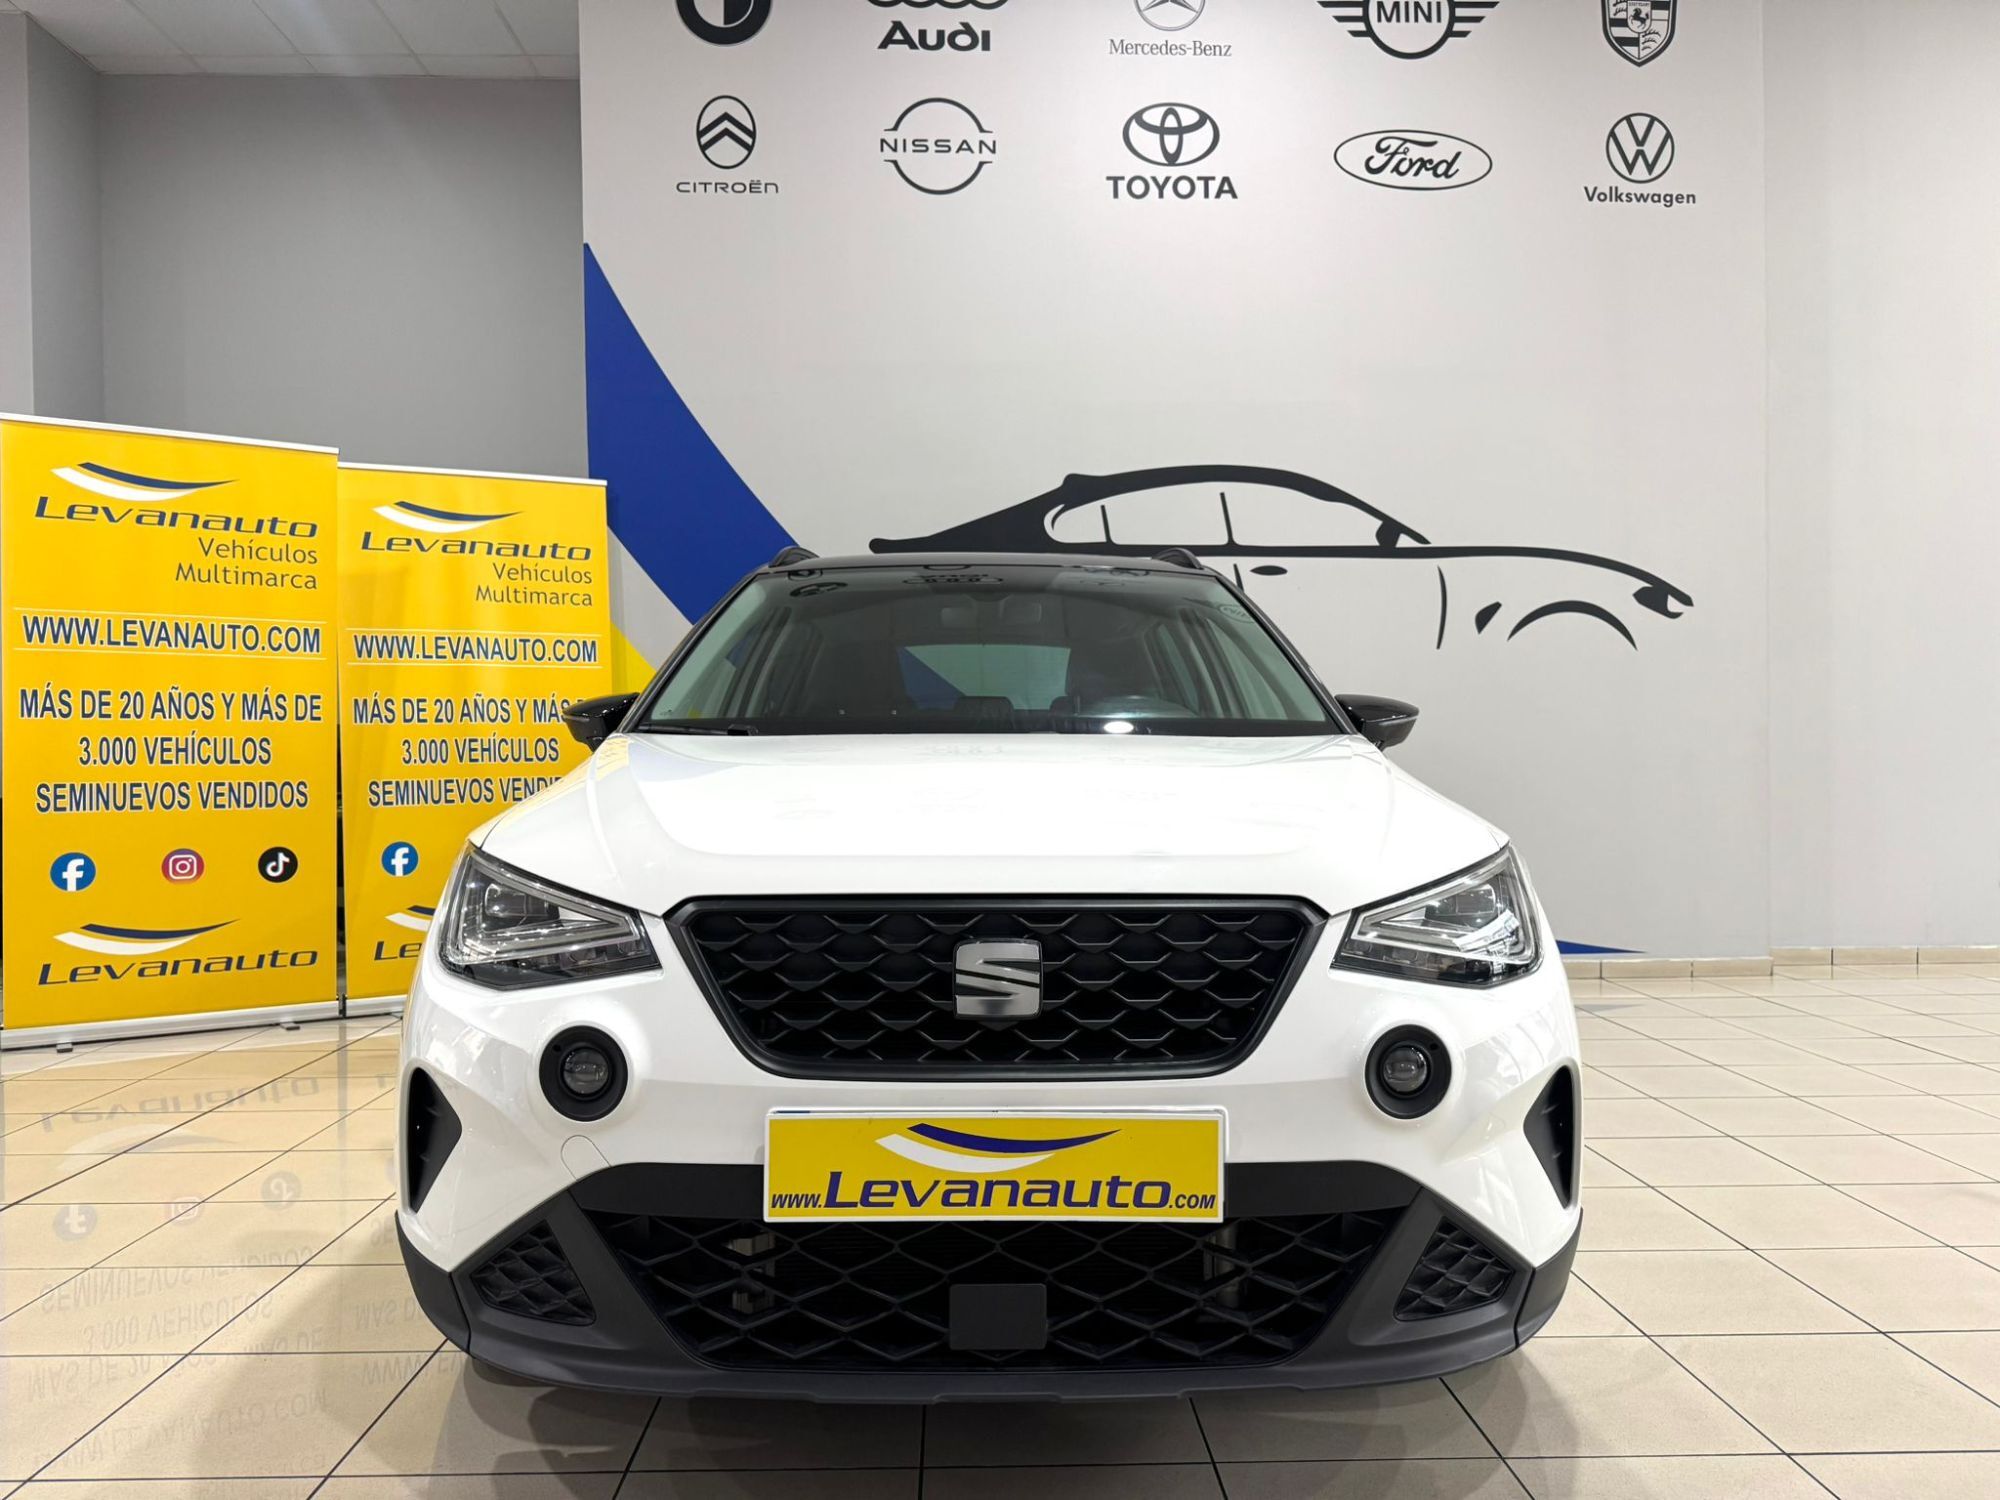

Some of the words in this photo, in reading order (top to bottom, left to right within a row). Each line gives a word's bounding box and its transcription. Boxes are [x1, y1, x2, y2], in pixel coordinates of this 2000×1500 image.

[1376, 1, 1443, 23] MINI
[878, 20, 991, 52] Audi
[1108, 38, 1232, 57] Mercedes-Benz
[880, 138, 996, 154] NISSAN
[1364, 136, 1460, 180] Ford
[1106, 175, 1238, 200] TOYOTA
[1584, 186, 1696, 208] Volkswagen
[35, 496, 318, 538] Levanauto
[198, 537, 318, 564] Vehículos
[361, 531, 592, 561] Levanauto
[175, 563, 318, 590] Multimarca
[492, 562, 593, 584] Vehículos
[475, 584, 593, 607] Multimarca
[23, 615, 320, 653] WWW.LEVANAUTO.COM
[353, 634, 597, 662] WWW.LEVANAUTO.COM
[20, 682, 72, 719] MÁS
[82, 690, 112, 719] DE
[120, 691, 144, 719] 20
[151, 686, 215, 720] AÑOS
[222, 693, 235, 720] Y
[243, 684, 287, 721] MÁS
[295, 694, 322, 721] DE
[353, 691, 396, 724] MÁS
[403, 698, 428, 723] DE
[434, 698, 454, 723] 20
[460, 693, 511, 723] AÑOS
[516, 699, 528, 723] Y
[79, 736, 136, 766] 3.000
[144, 729, 271, 765] VEHÍCULOS
[402, 738, 449, 764] 3.000
[455, 732, 560, 763] VEHÍCULOS
[37, 781, 191, 813] SEMINUEVOS
[198, 780, 308, 810] VENDIDOS
[368, 778, 494, 806] SEMINUEVOS
[499, 776, 563, 802] VEND
[38, 948, 318, 986] Levanauto
